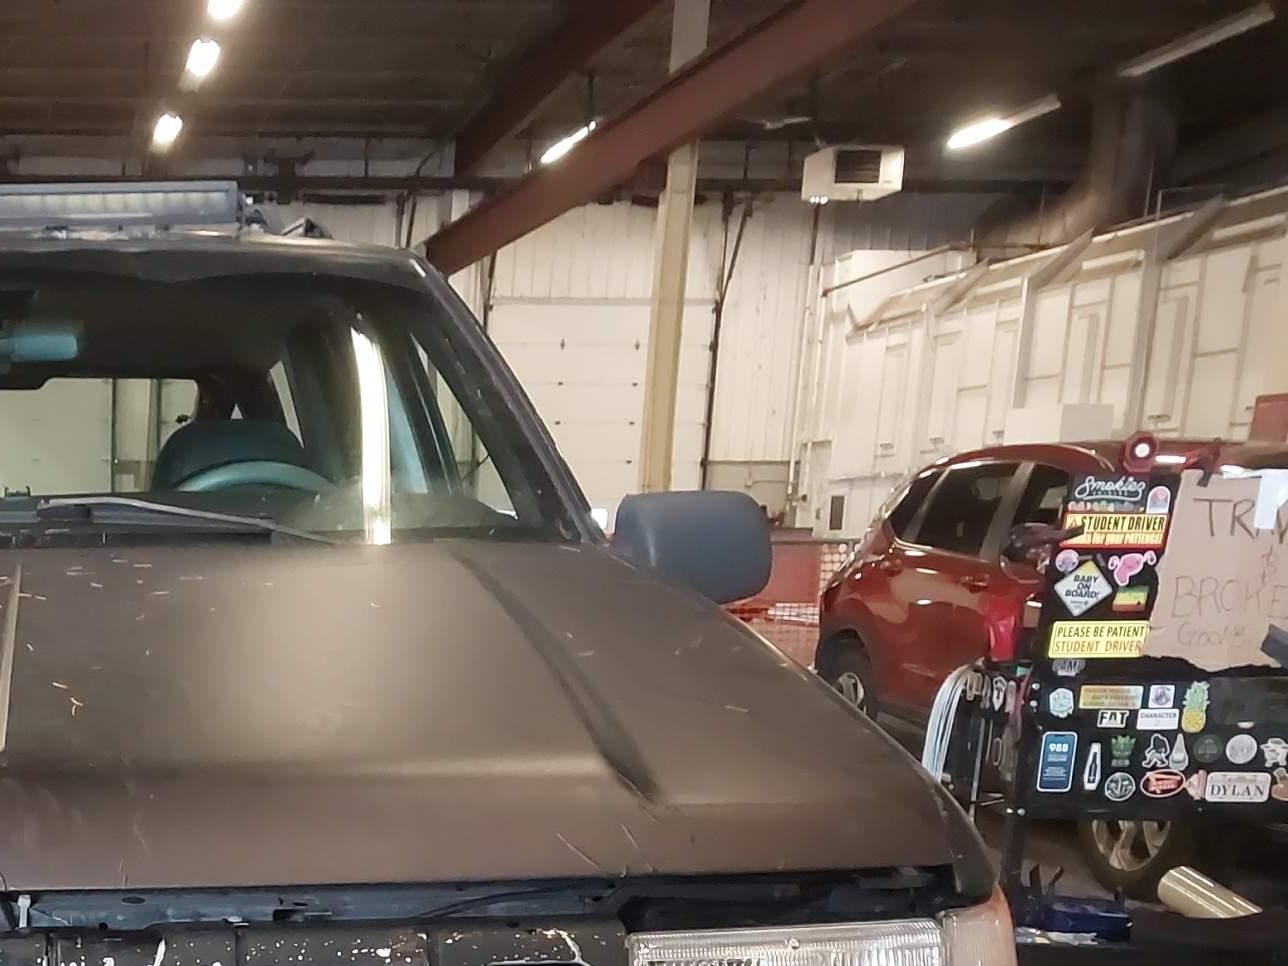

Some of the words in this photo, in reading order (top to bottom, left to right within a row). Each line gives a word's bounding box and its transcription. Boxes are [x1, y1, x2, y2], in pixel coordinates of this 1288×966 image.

[1081, 516, 1126, 531] STUDENT
[1127, 516, 1165, 531] DRIVER
[1073, 575, 1099, 583] BABY
[1057, 626, 1091, 637] PLEASE
[1093, 626, 1105, 637] BE
[1107, 626, 1145, 637] PATIENT
[1055, 641, 1100, 652] STUDENT
[1105, 641, 1142, 652] DRIVER
[1099, 711, 1127, 725] FAT
[1211, 785, 1265, 797] DYLAN
